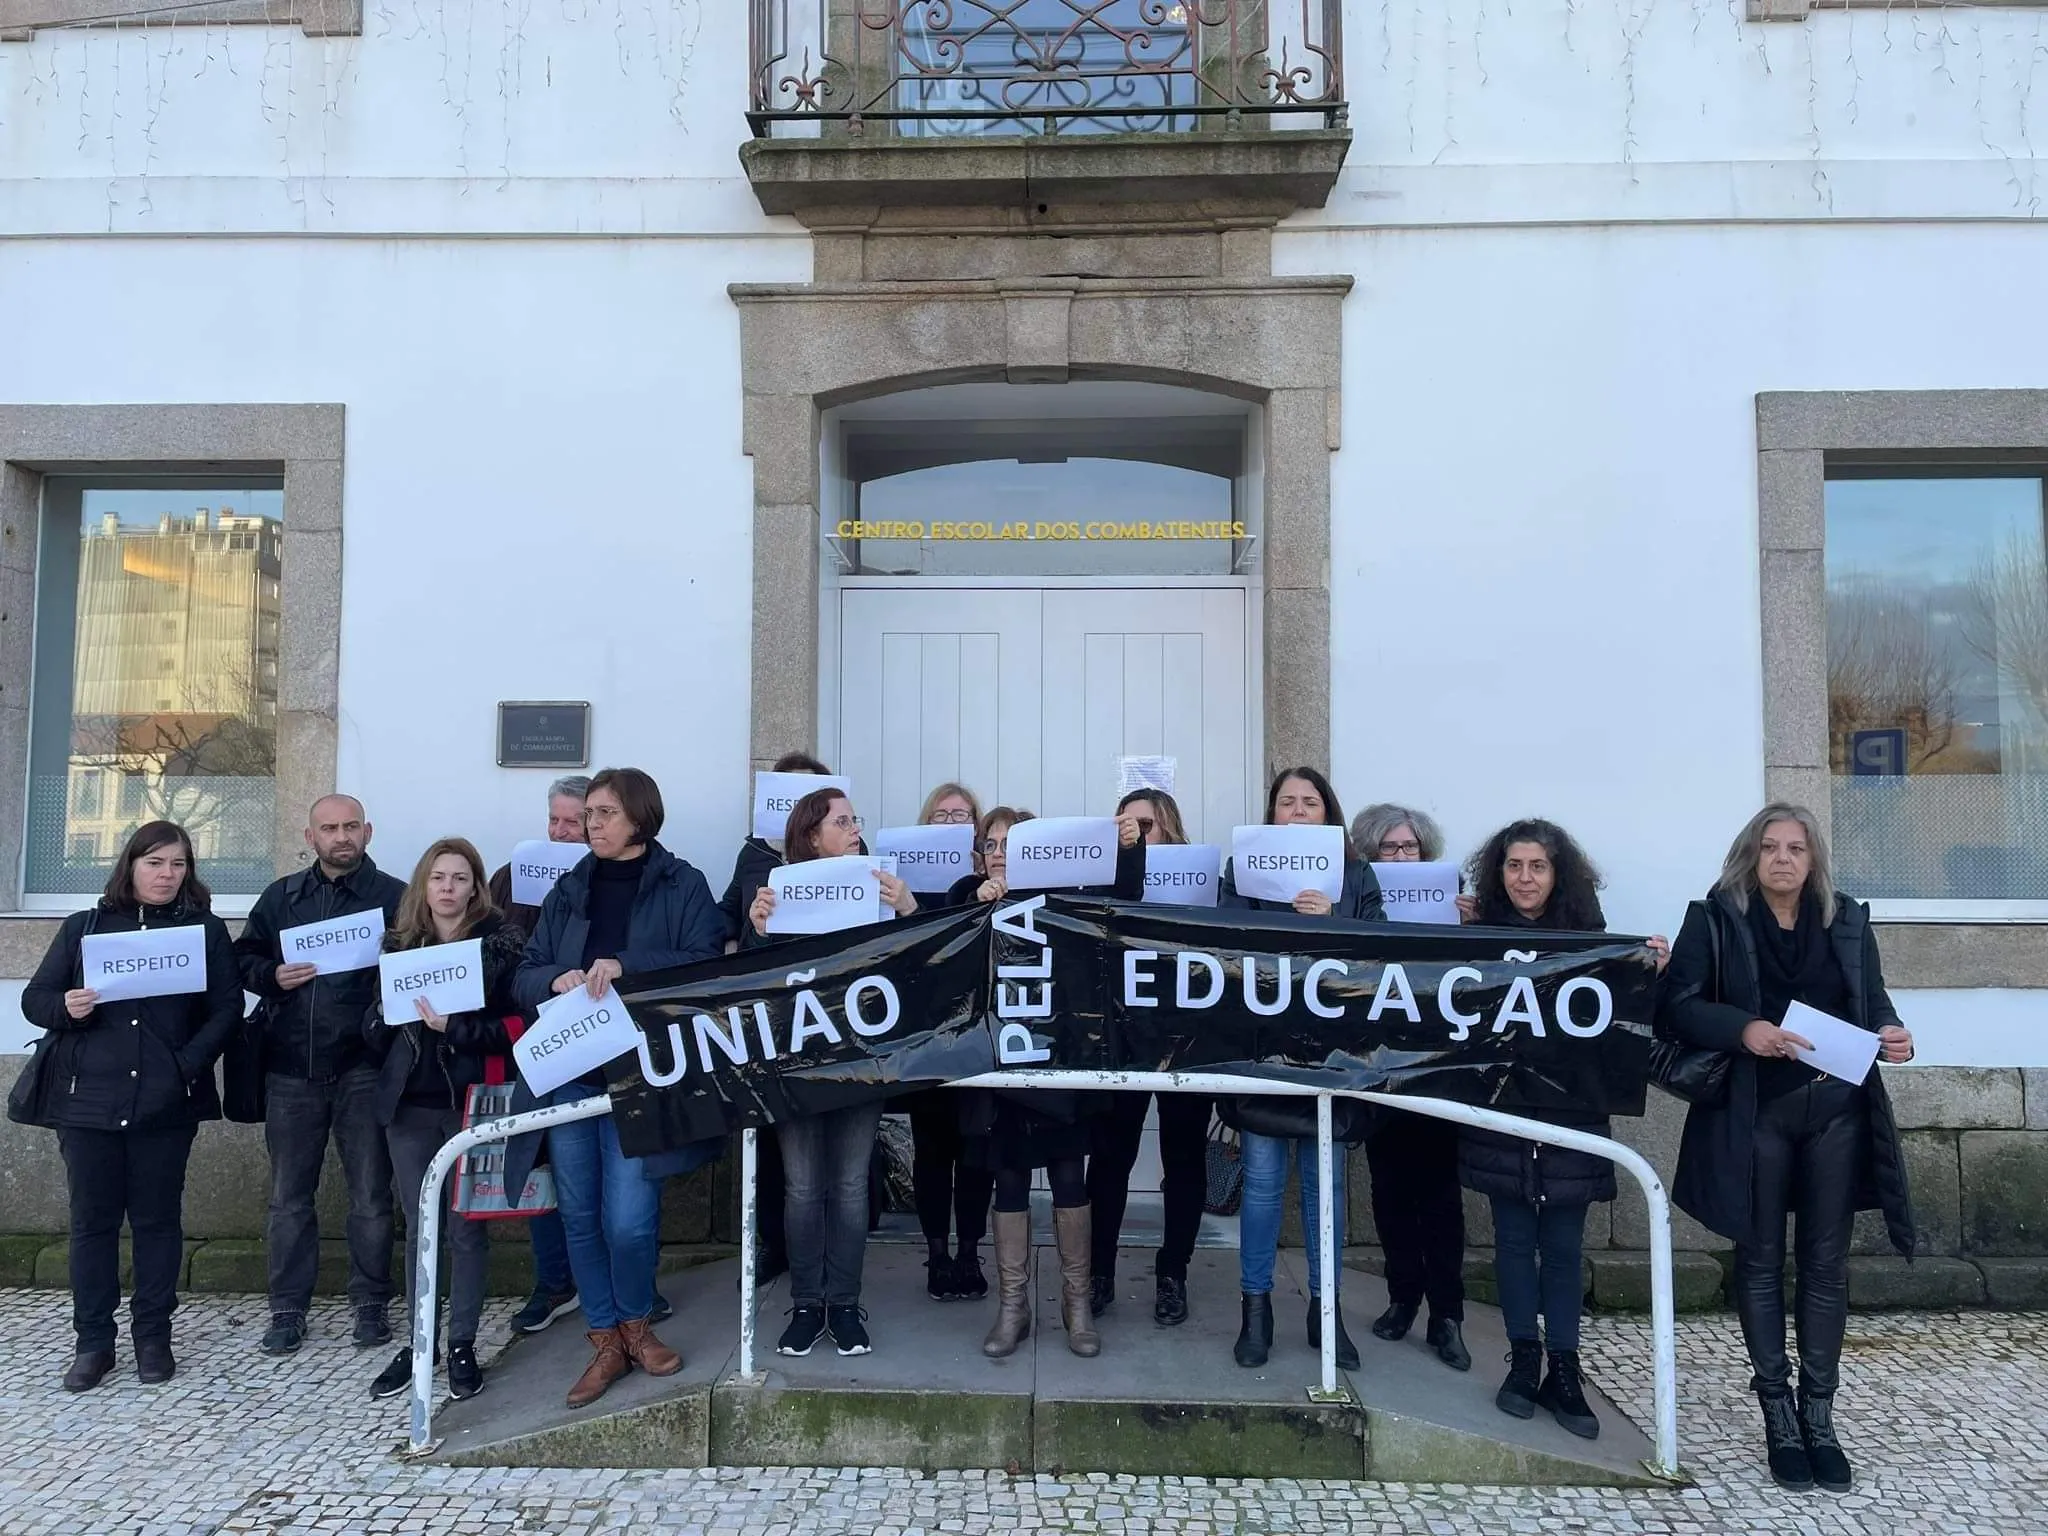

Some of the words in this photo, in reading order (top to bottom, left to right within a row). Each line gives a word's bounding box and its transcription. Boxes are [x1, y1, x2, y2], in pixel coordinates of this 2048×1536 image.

[837, 520, 924, 539] CENTRO
[931, 521, 1029, 539] ESCOLAR
[1035, 521, 1080, 539] DOS
[1085, 521, 1245, 539] COMBATENTES
[1021, 845, 1103, 861] RESPEITO
[1247, 854, 1329, 872] RESPEITO
[1144, 871, 1207, 886] ESPEITO
[782, 885, 865, 901] RESPEITO
[295, 926, 372, 951] RESPEITO
[102, 953, 190, 974] RESPEITO
[393, 965, 468, 993] RESPEITO
[636, 967, 901, 1088] UNIÃO
[991, 894, 1053, 1065] PELA
[1123, 949, 1614, 1041] EDUCAÇÃO
[529, 1008, 611, 1062] RESPEITO
